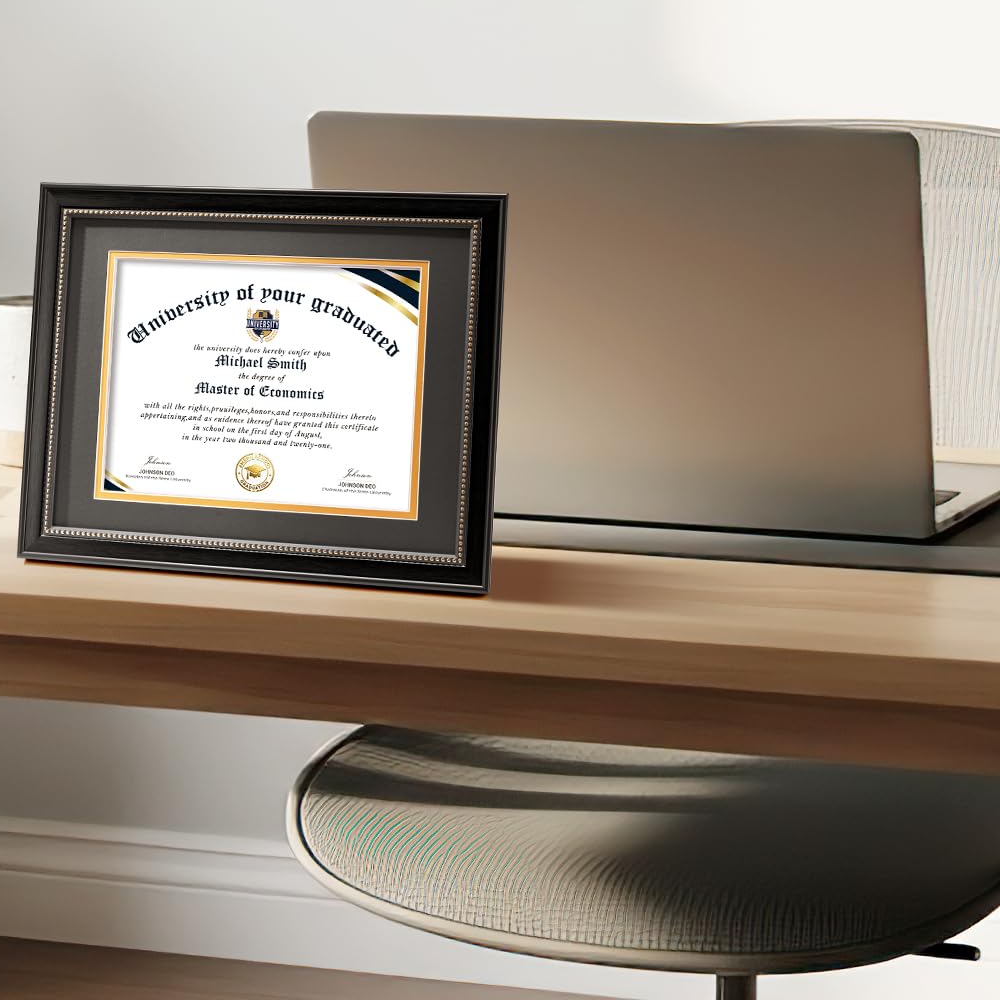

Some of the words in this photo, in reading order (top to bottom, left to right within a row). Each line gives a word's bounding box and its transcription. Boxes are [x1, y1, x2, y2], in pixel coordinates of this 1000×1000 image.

[127, 289, 230, 344] University
[236, 284, 255, 300] of
[260, 287, 306, 304] your
[310, 297, 400, 358] graduated
[246, 319, 280, 329] UNIVERSITY
[193, 343, 204, 351] the
[206, 344, 242, 355] university
[263, 347, 286, 357] hereby
[288, 348, 311, 358] confer
[313, 350, 331, 359] upon
[214, 354, 263, 369] Michael
[267, 357, 307, 372] Smith
[251, 373, 276, 382] degree
[277, 374, 287, 383] of
[194, 381, 240, 395] Master
[244, 384, 256, 396] of
[259, 385, 325, 400] Economics
[143, 401, 160, 409] with
[162, 402, 173, 410] all
[174, 402, 186, 411] the
[292, 411, 349, 420] responsibilities
[350, 412, 377, 421] thereto
[192, 423, 201, 431] in
[202, 424, 225, 433] school
[237, 426, 249, 434] the
[249, 427, 267, 437] first
[269, 428, 282, 438] day
[284, 429, 294, 439] of
[246, 416, 274, 428] thereof
[274, 418, 292, 427] have
[293, 420, 322, 429] granted
[324, 421, 339, 429] this
[340, 422, 380, 432] certificate
[181, 433, 190, 441] in
[191, 433, 203, 441] the
[203, 435, 220, 444] year
[238, 436, 272, 445] thousand
[273, 439, 288, 447] and
